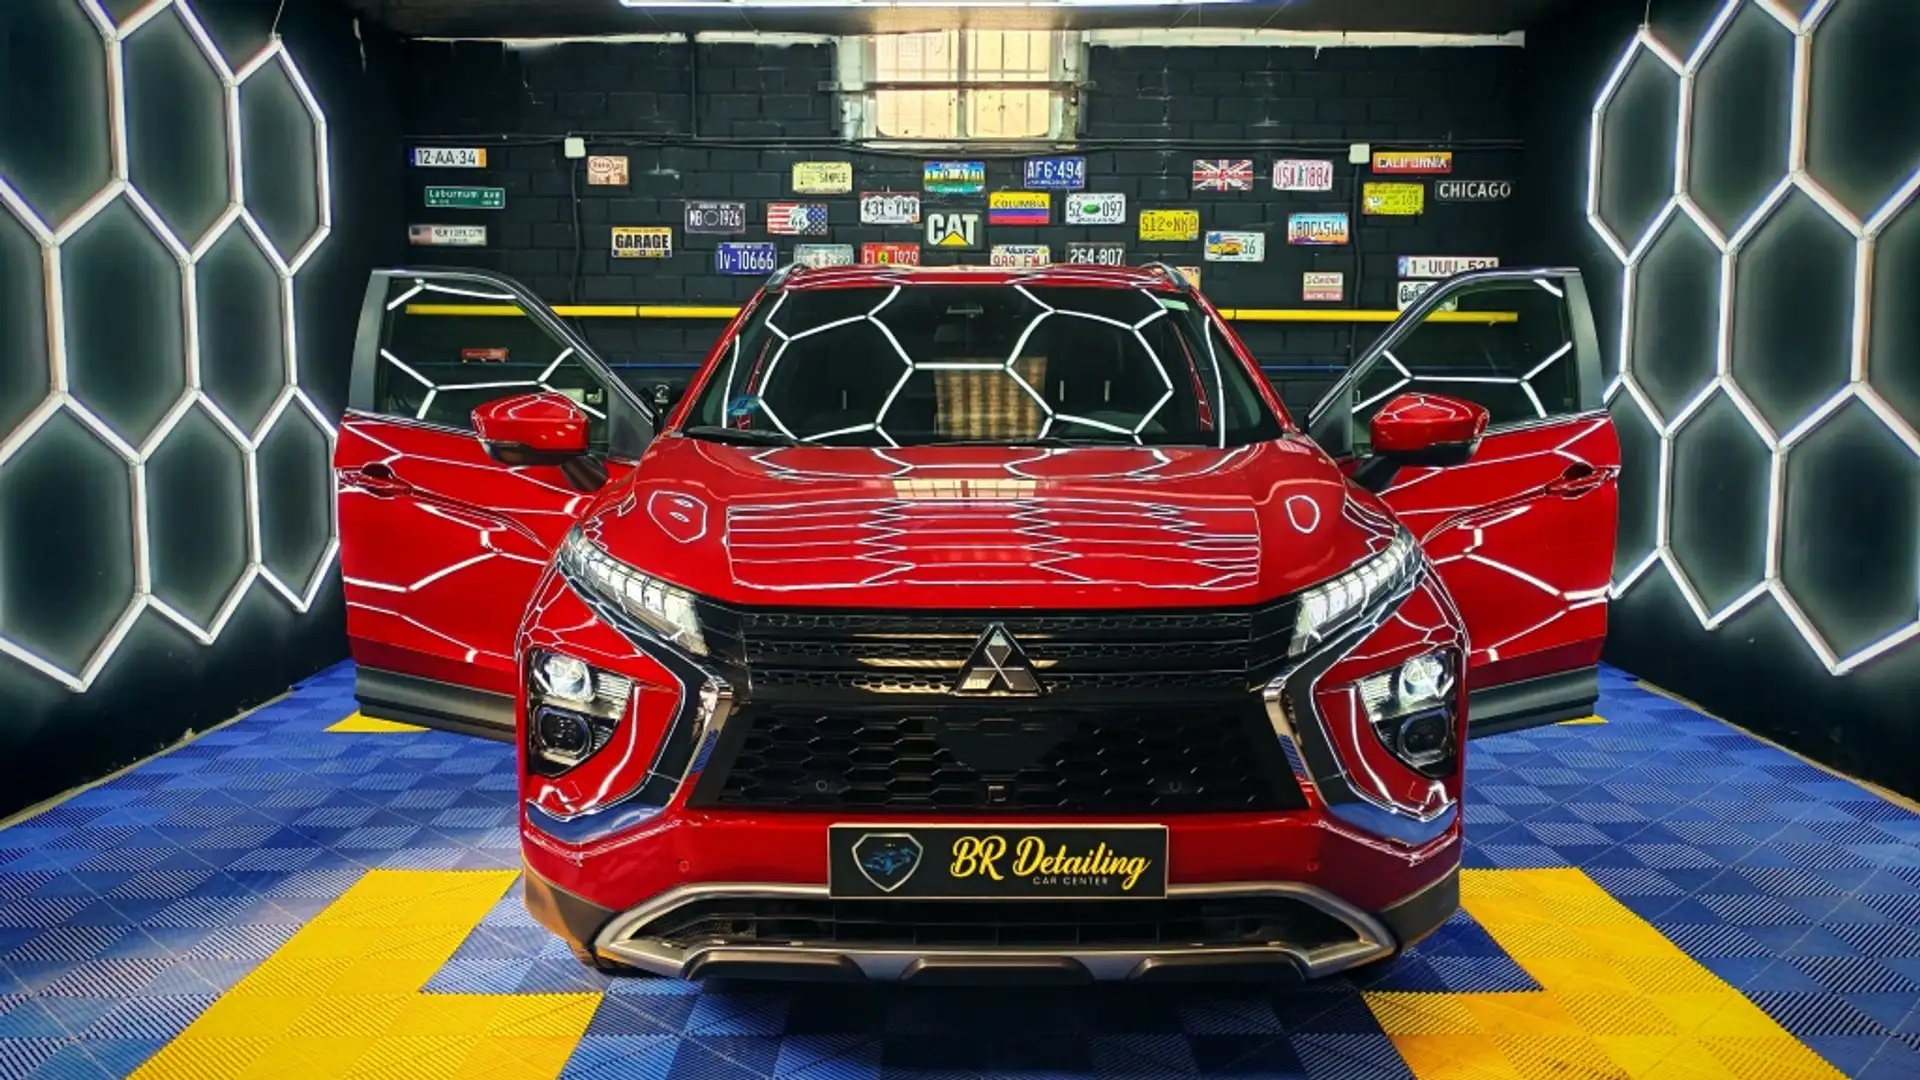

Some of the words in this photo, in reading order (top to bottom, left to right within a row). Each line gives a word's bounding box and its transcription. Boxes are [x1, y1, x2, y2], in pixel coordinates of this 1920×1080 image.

[1439, 183, 1511, 199] CHICAGO
[927, 213, 979, 246] CAT
[615, 234, 669, 249] GARAGE
[950, 835, 1007, 881] BR
[1012, 835, 1152, 891] Detailing
[1032, 875, 1057, 886] CAR
[1062, 875, 1109, 886] CENTER
